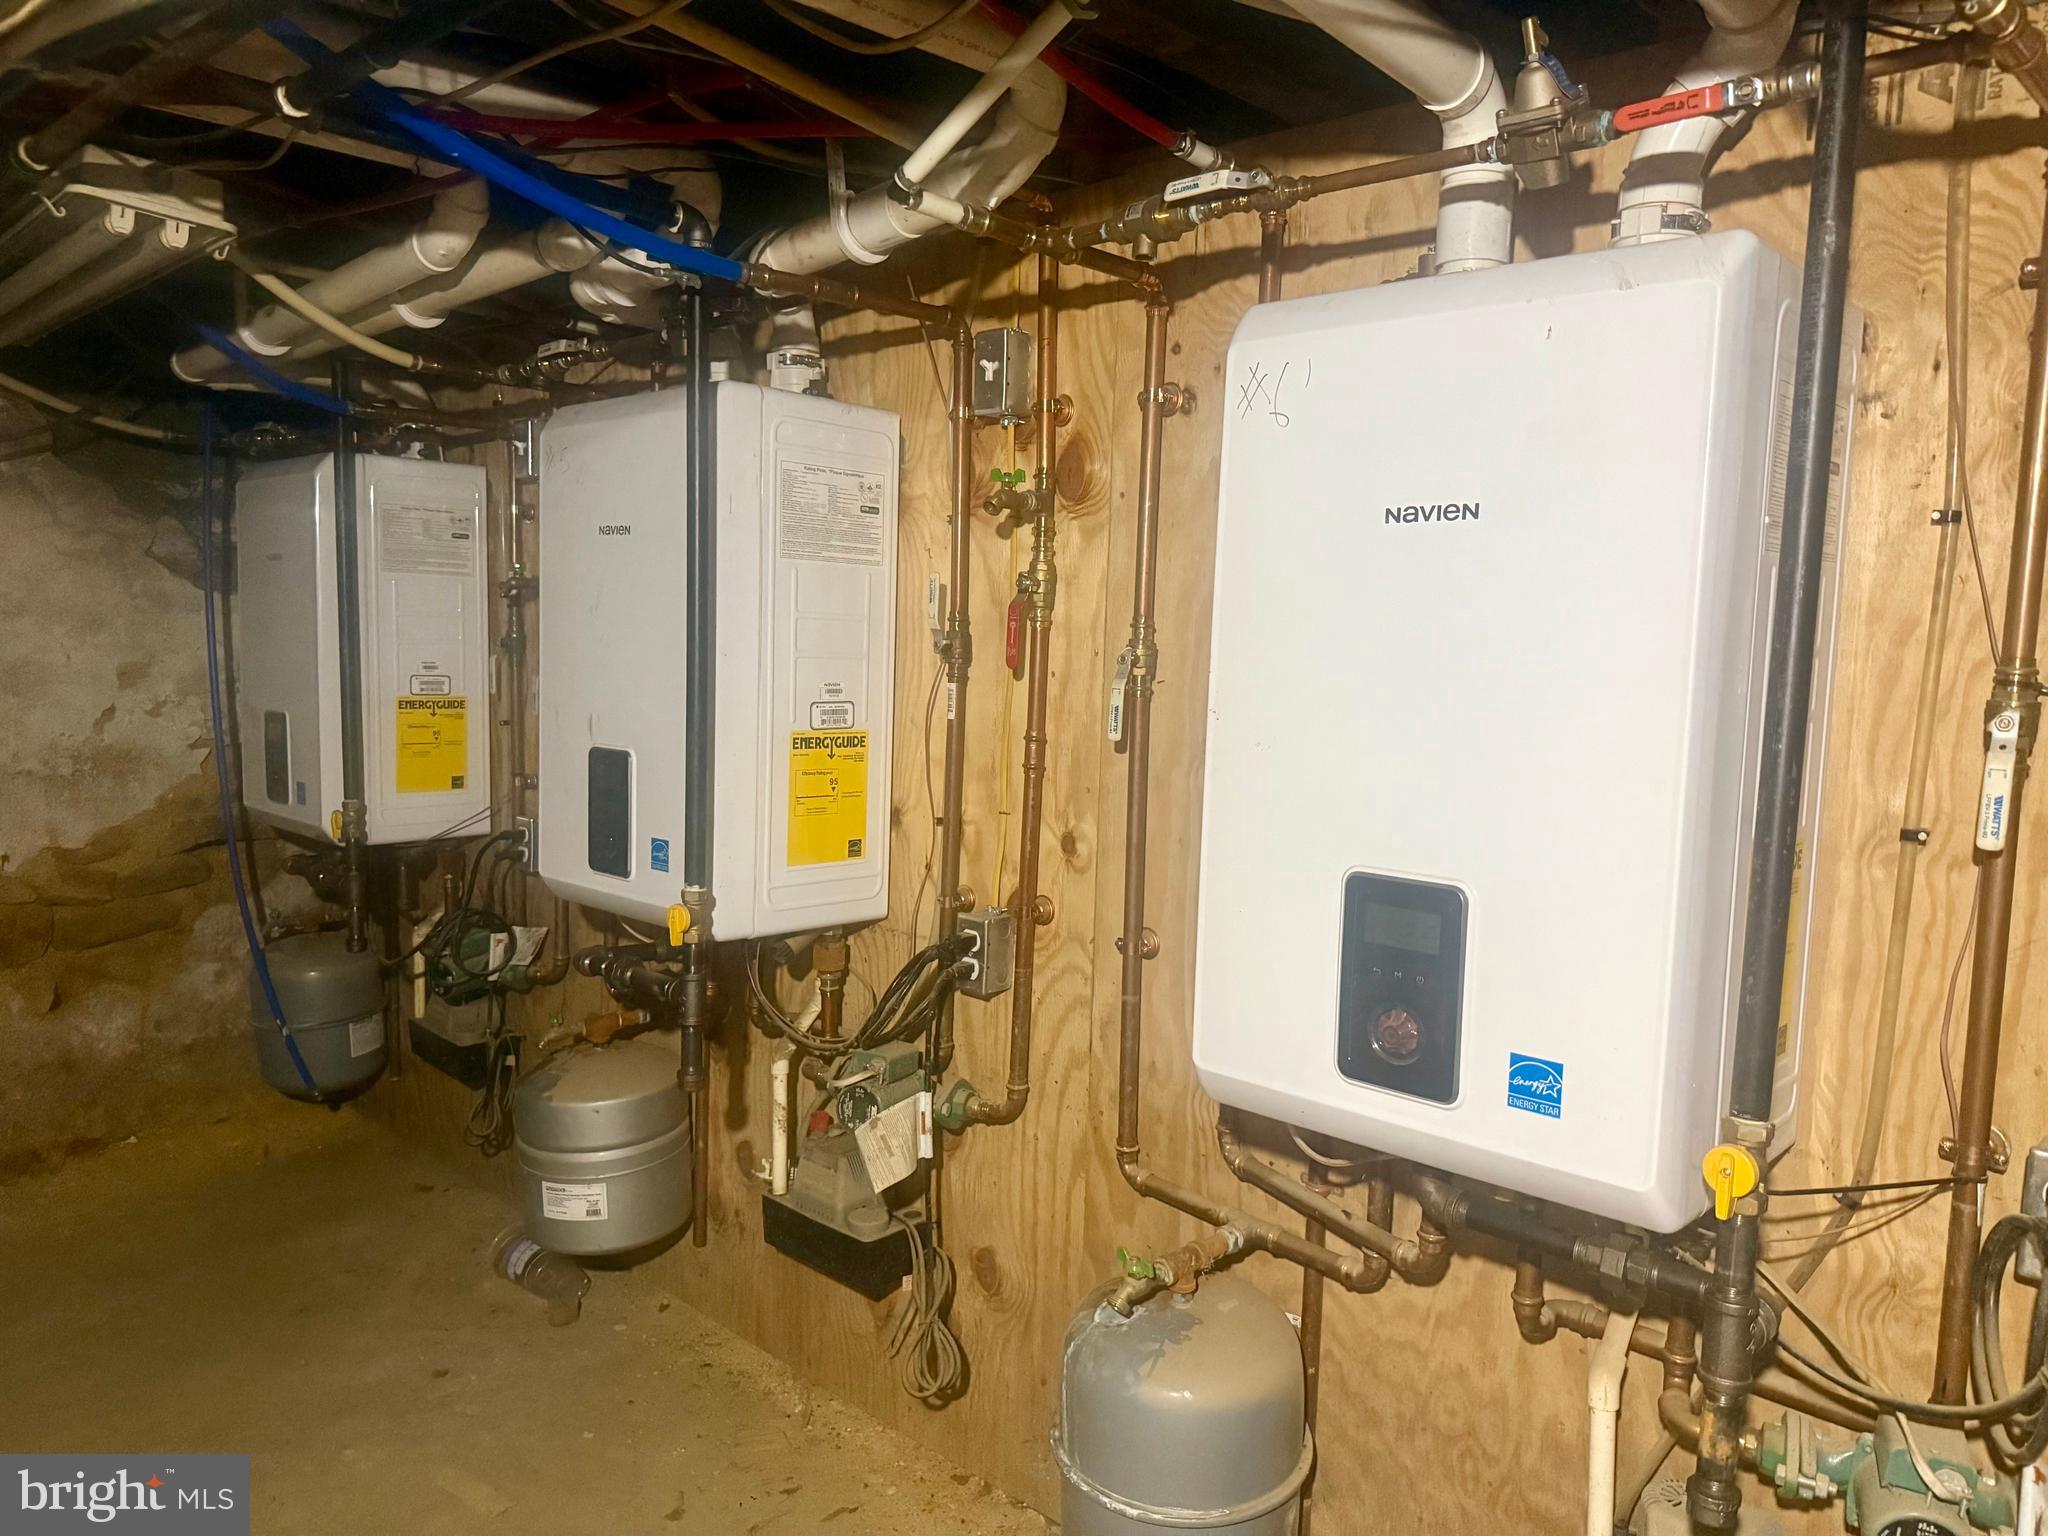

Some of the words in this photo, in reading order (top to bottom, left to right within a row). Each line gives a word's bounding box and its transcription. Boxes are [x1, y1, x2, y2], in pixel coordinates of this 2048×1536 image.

[1988, 65, 2004, 101] RAT
[398, 700, 466, 711] ENERGYGUIDE
[793, 736, 866, 751] ENERGYGUIDE
[830, 778, 838, 786] 95
[1990, 795, 2004, 841] WATTS
[1509, 1096, 1539, 1111] ENERGY
[1539, 1103, 1560, 1117] STAR
